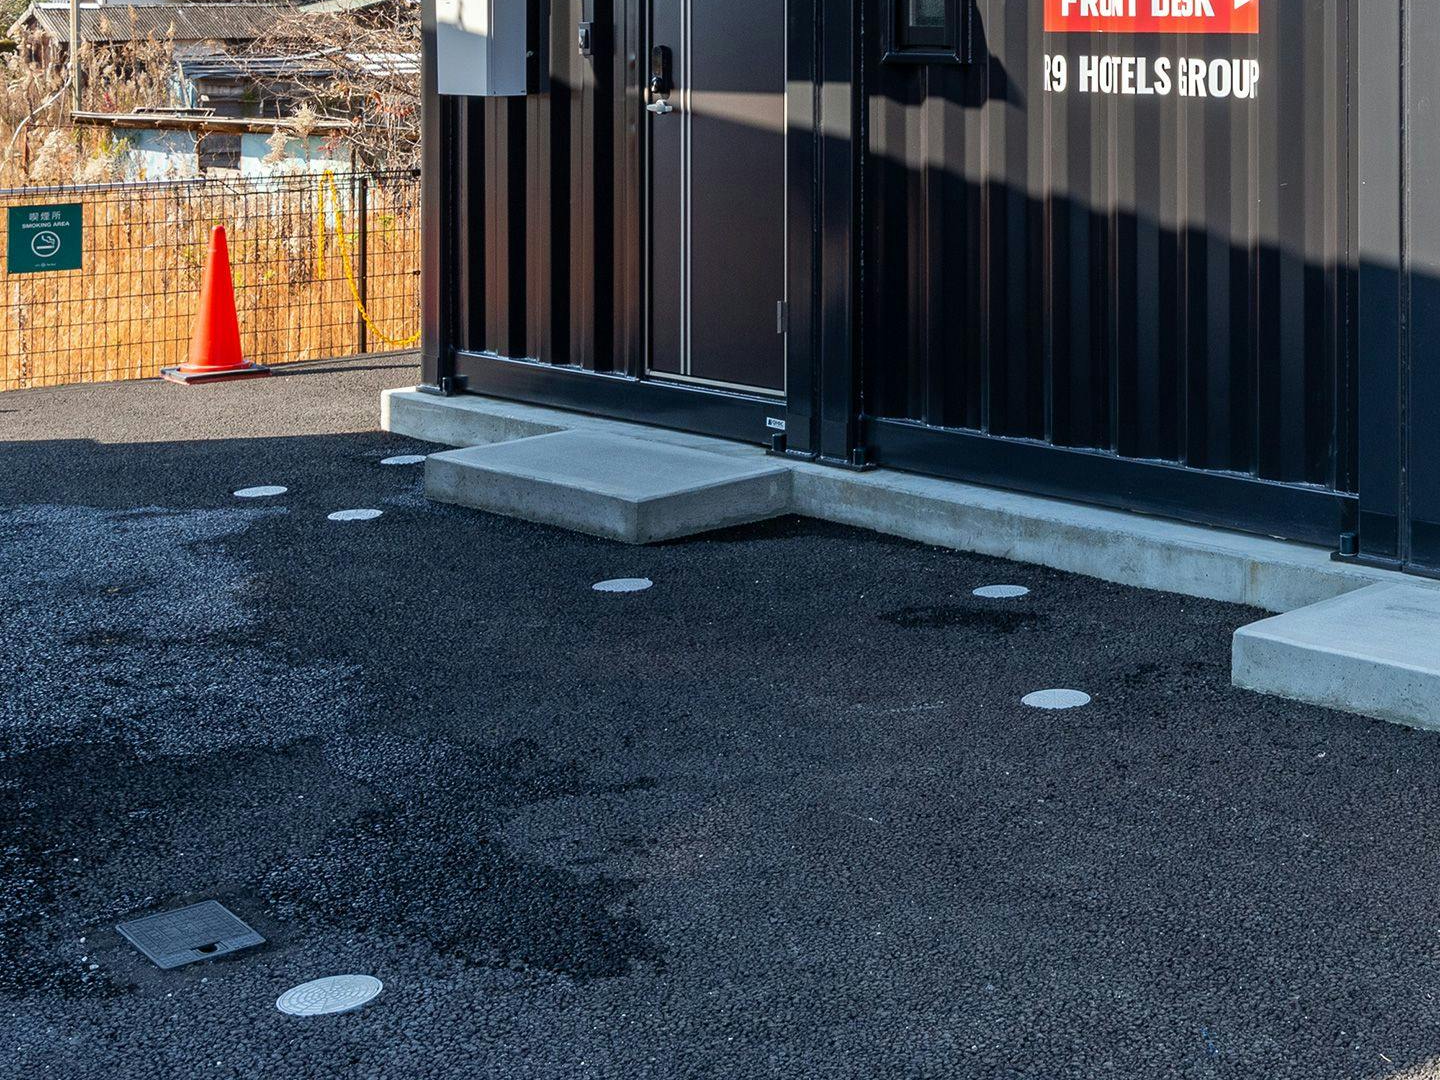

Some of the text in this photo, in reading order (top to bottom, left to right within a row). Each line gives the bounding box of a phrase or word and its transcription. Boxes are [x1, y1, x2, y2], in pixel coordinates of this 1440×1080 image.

[1044, 53, 1260, 99] R9 HOTELS GROUP
